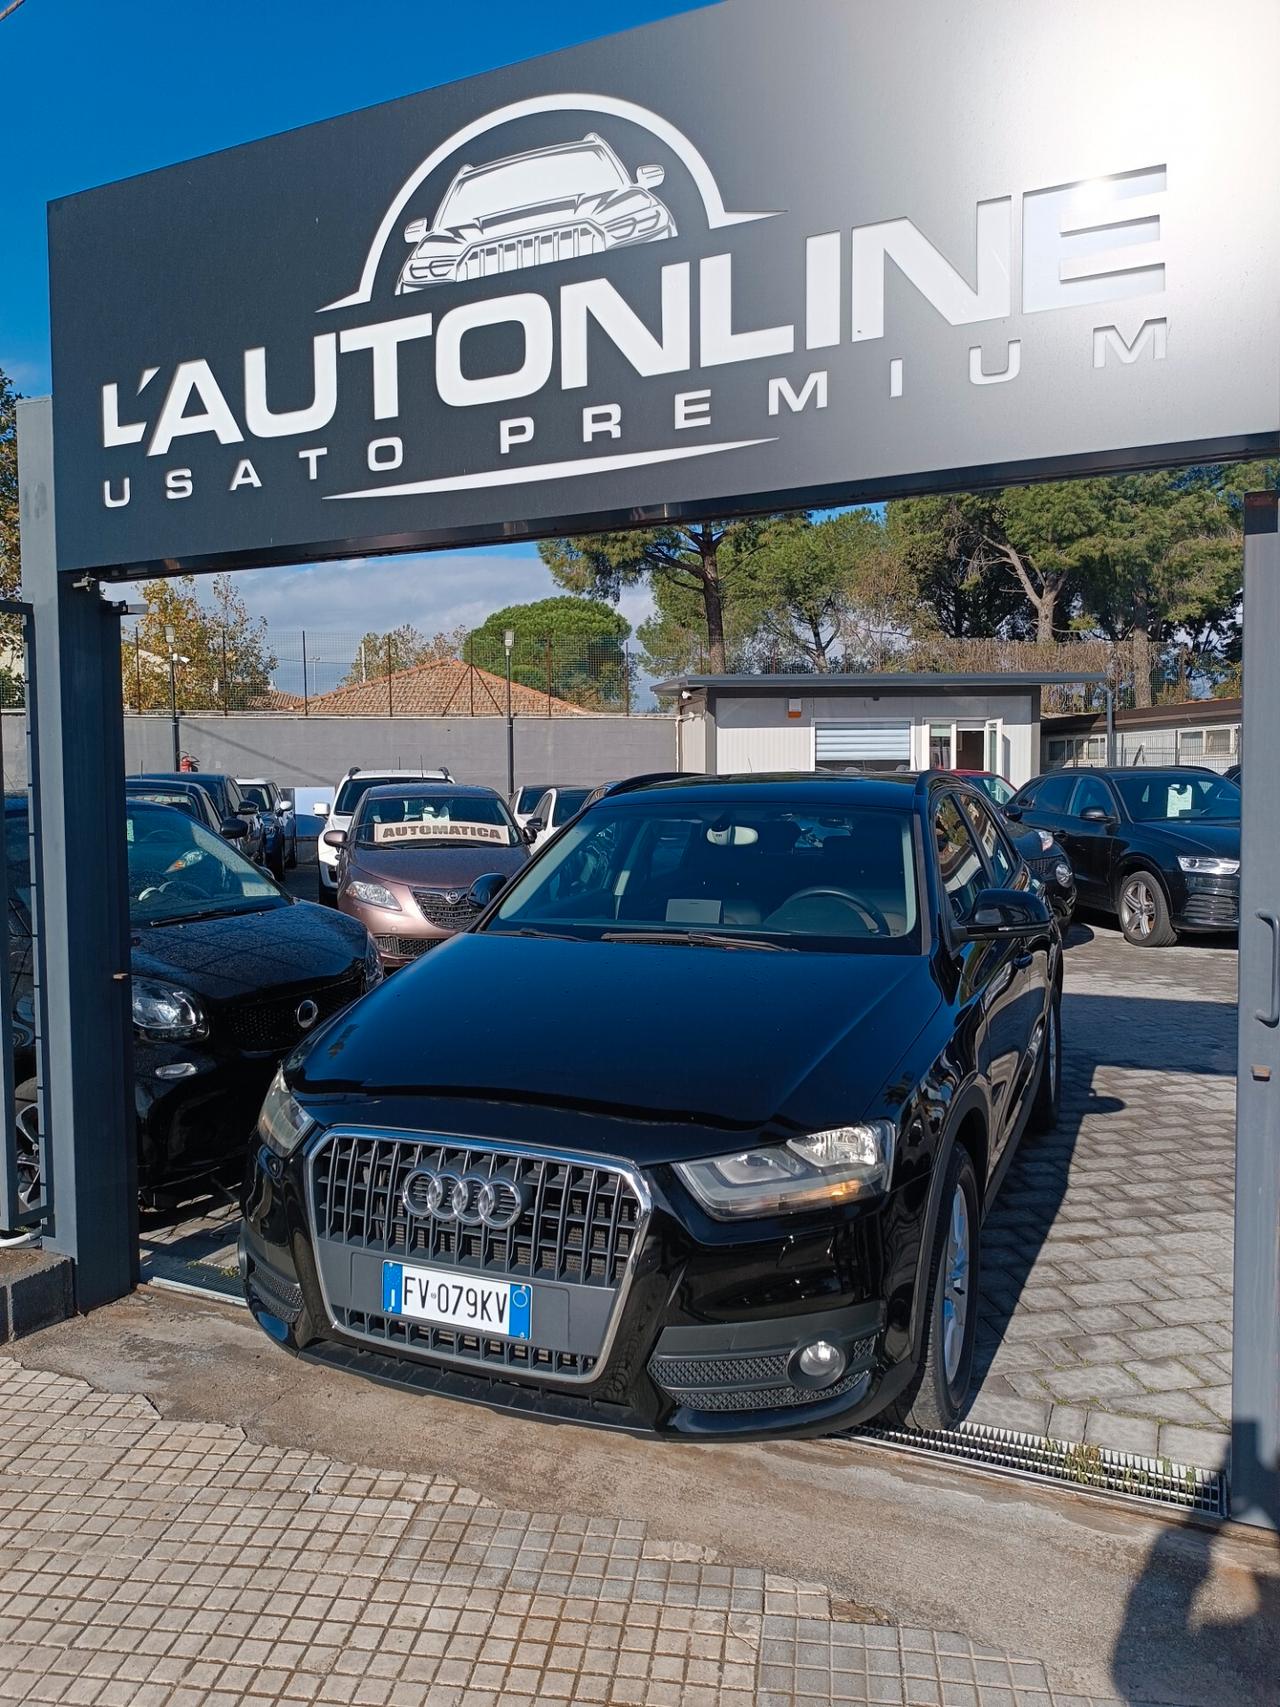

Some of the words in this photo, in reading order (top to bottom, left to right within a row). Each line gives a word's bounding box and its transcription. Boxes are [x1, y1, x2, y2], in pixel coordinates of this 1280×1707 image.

[103, 163, 1168, 456] L'AUTONLINE
[104, 436, 404, 508] USATO
[499, 316, 1168, 455] PREMIUM
[382, 825, 501, 840] AUTOMATICA
